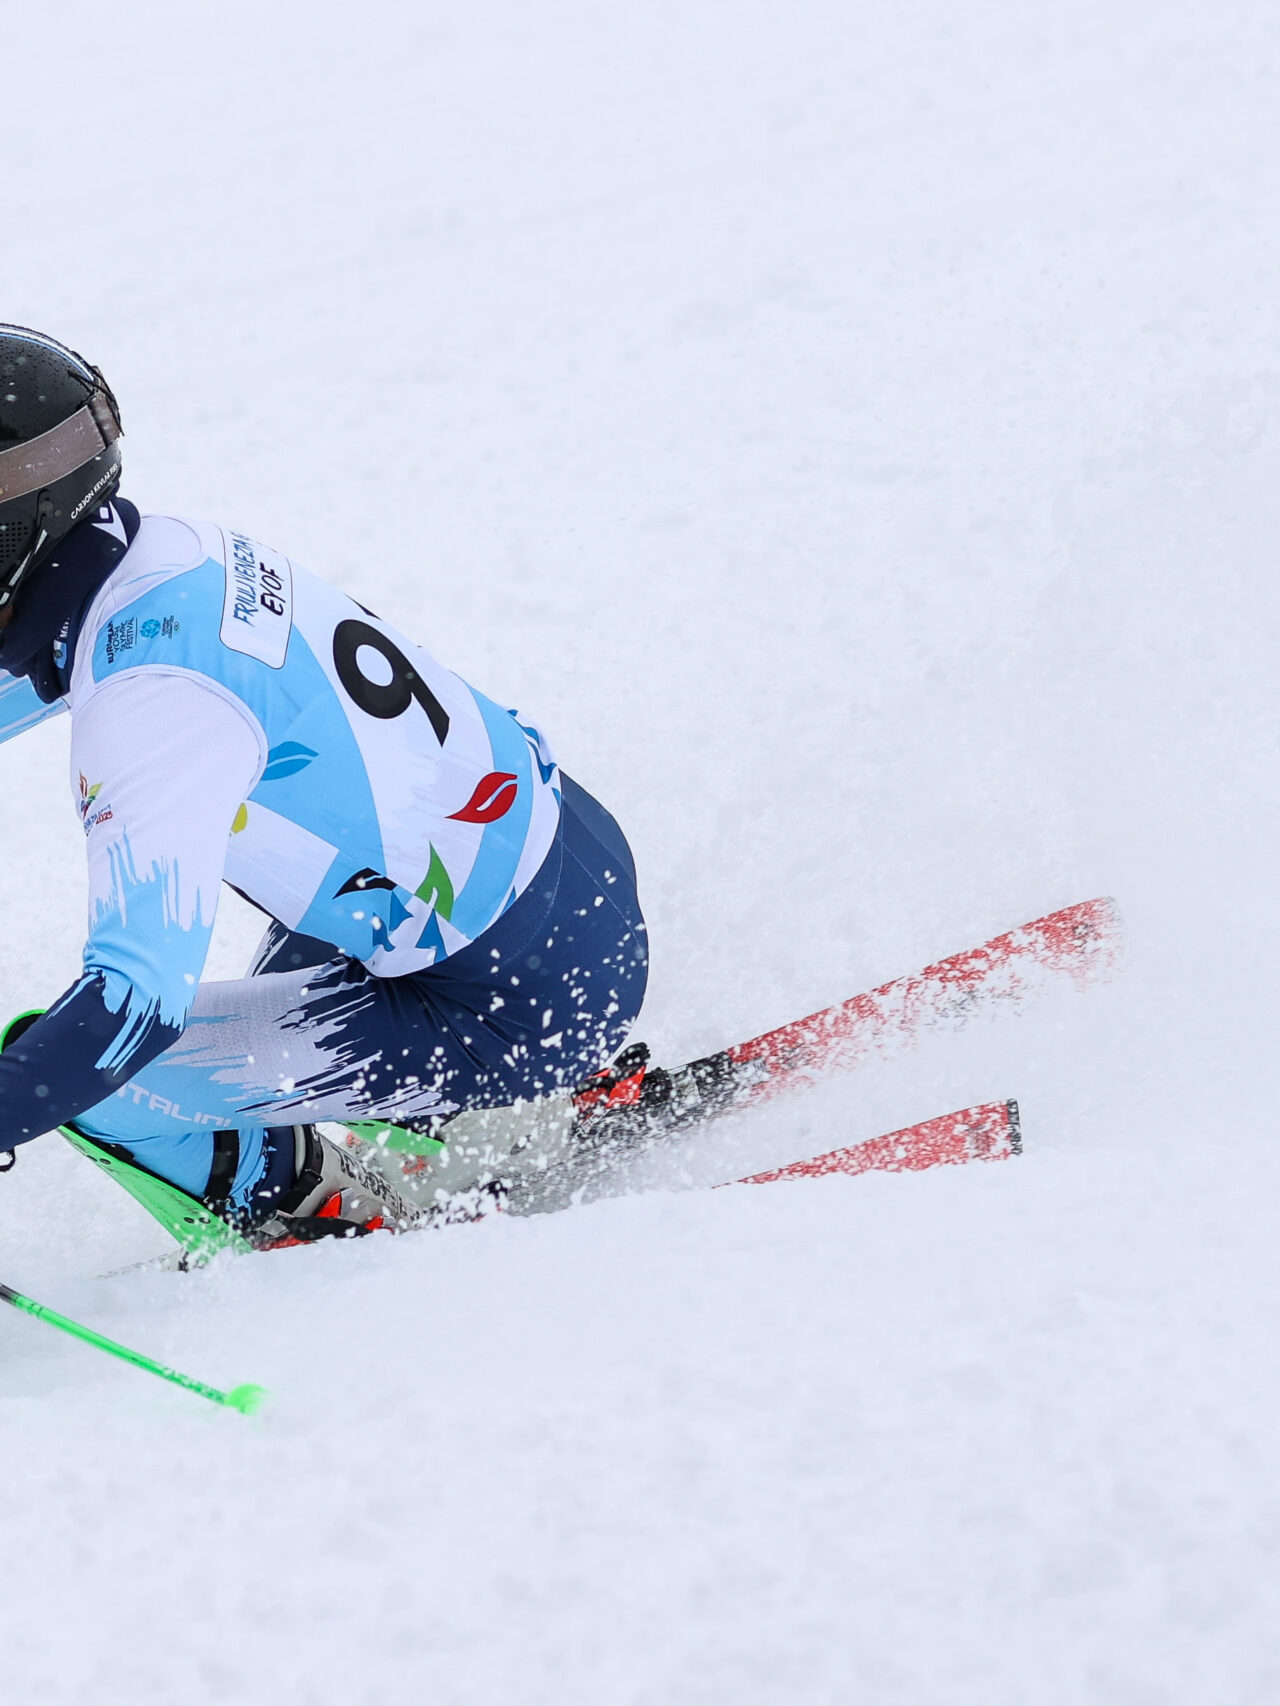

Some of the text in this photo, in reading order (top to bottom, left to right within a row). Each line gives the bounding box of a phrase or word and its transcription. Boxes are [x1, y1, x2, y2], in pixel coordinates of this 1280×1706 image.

[70, 490, 95, 519] CARBON
[259, 561, 286, 617] EYOF
[332, 593, 450, 749] 9
